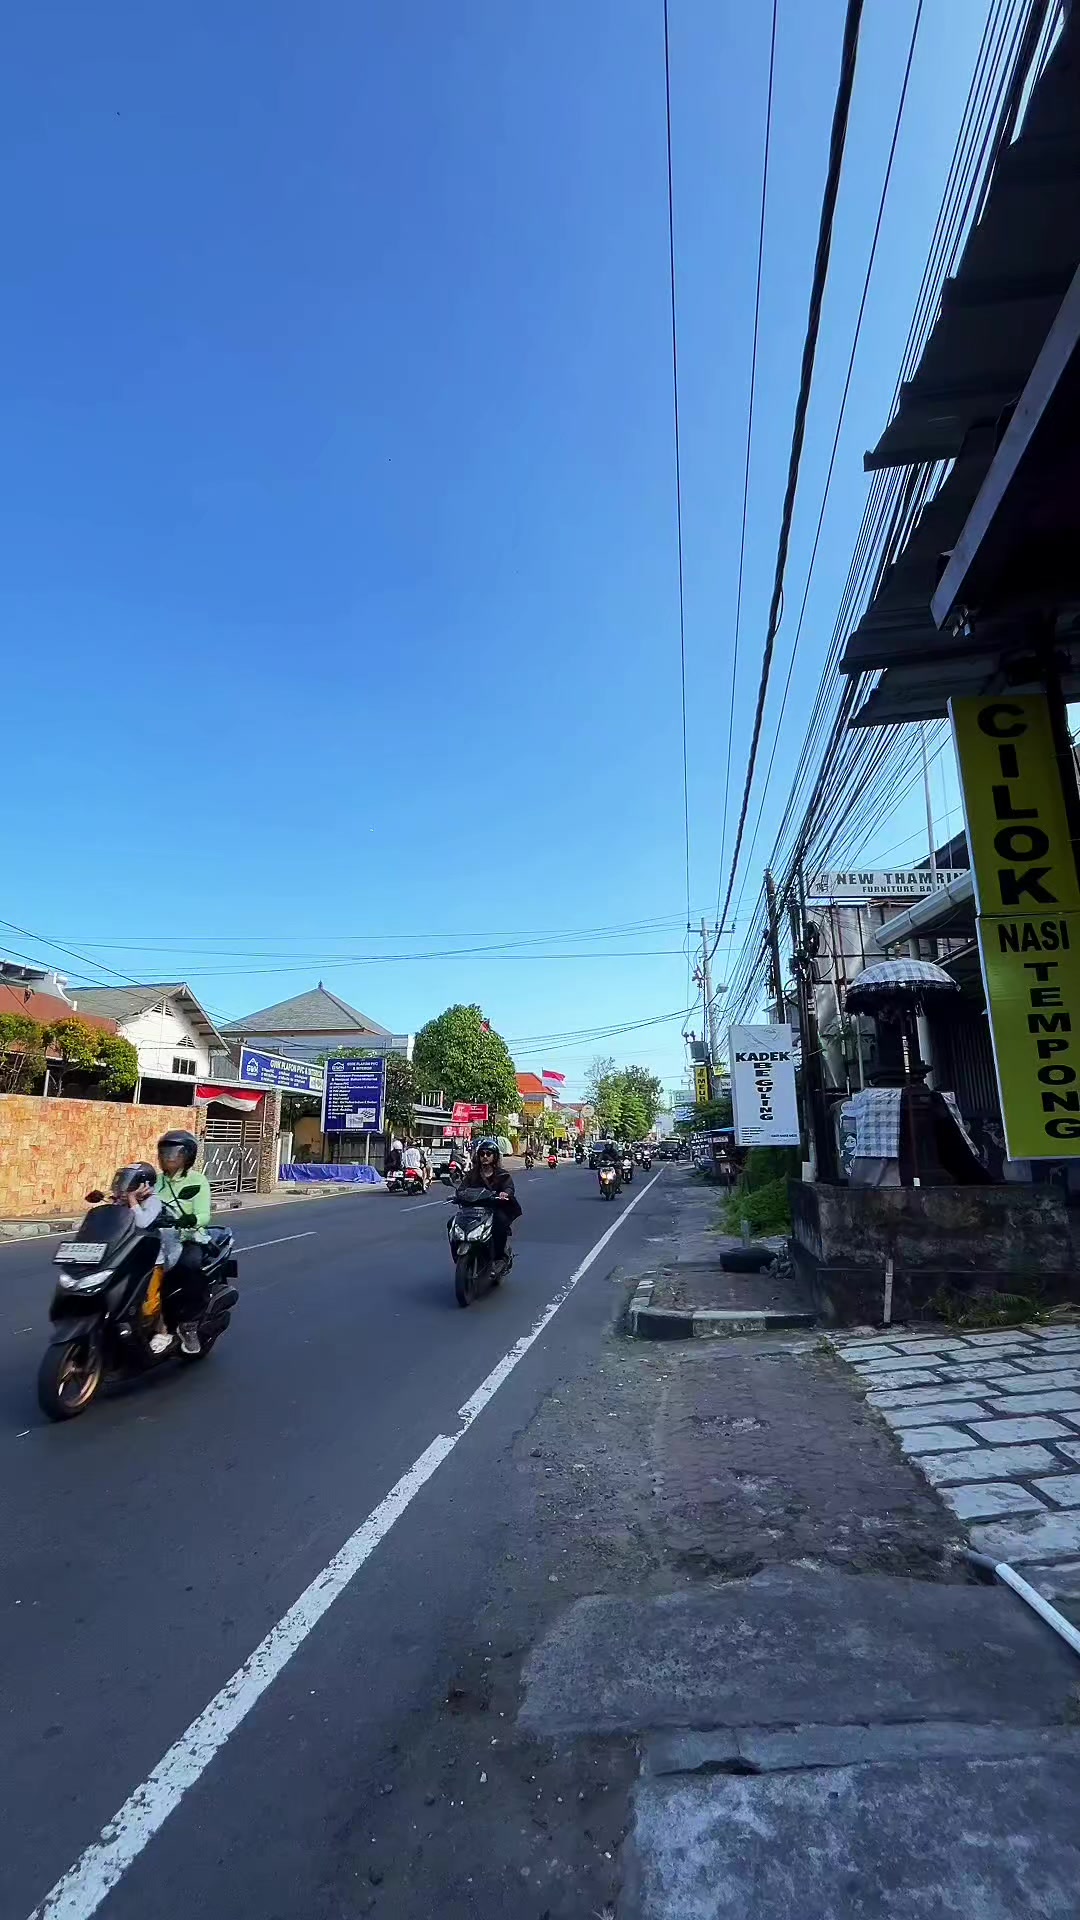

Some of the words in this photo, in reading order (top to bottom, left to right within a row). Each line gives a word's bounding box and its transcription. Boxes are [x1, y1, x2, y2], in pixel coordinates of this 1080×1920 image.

[977, 703, 1060, 906] CILOK
[836, 873, 874, 885] NEW
[862, 885, 915, 893] FURNITURE
[919, 885, 940, 893] BAI
[997, 920, 1070, 953] NASI
[735, 1051, 791, 1062] KADEK
[1023, 961, 1080, 1139] TEMPONG
[753, 1062, 773, 1077] BE
[755, 1079, 774, 1121] GULING
